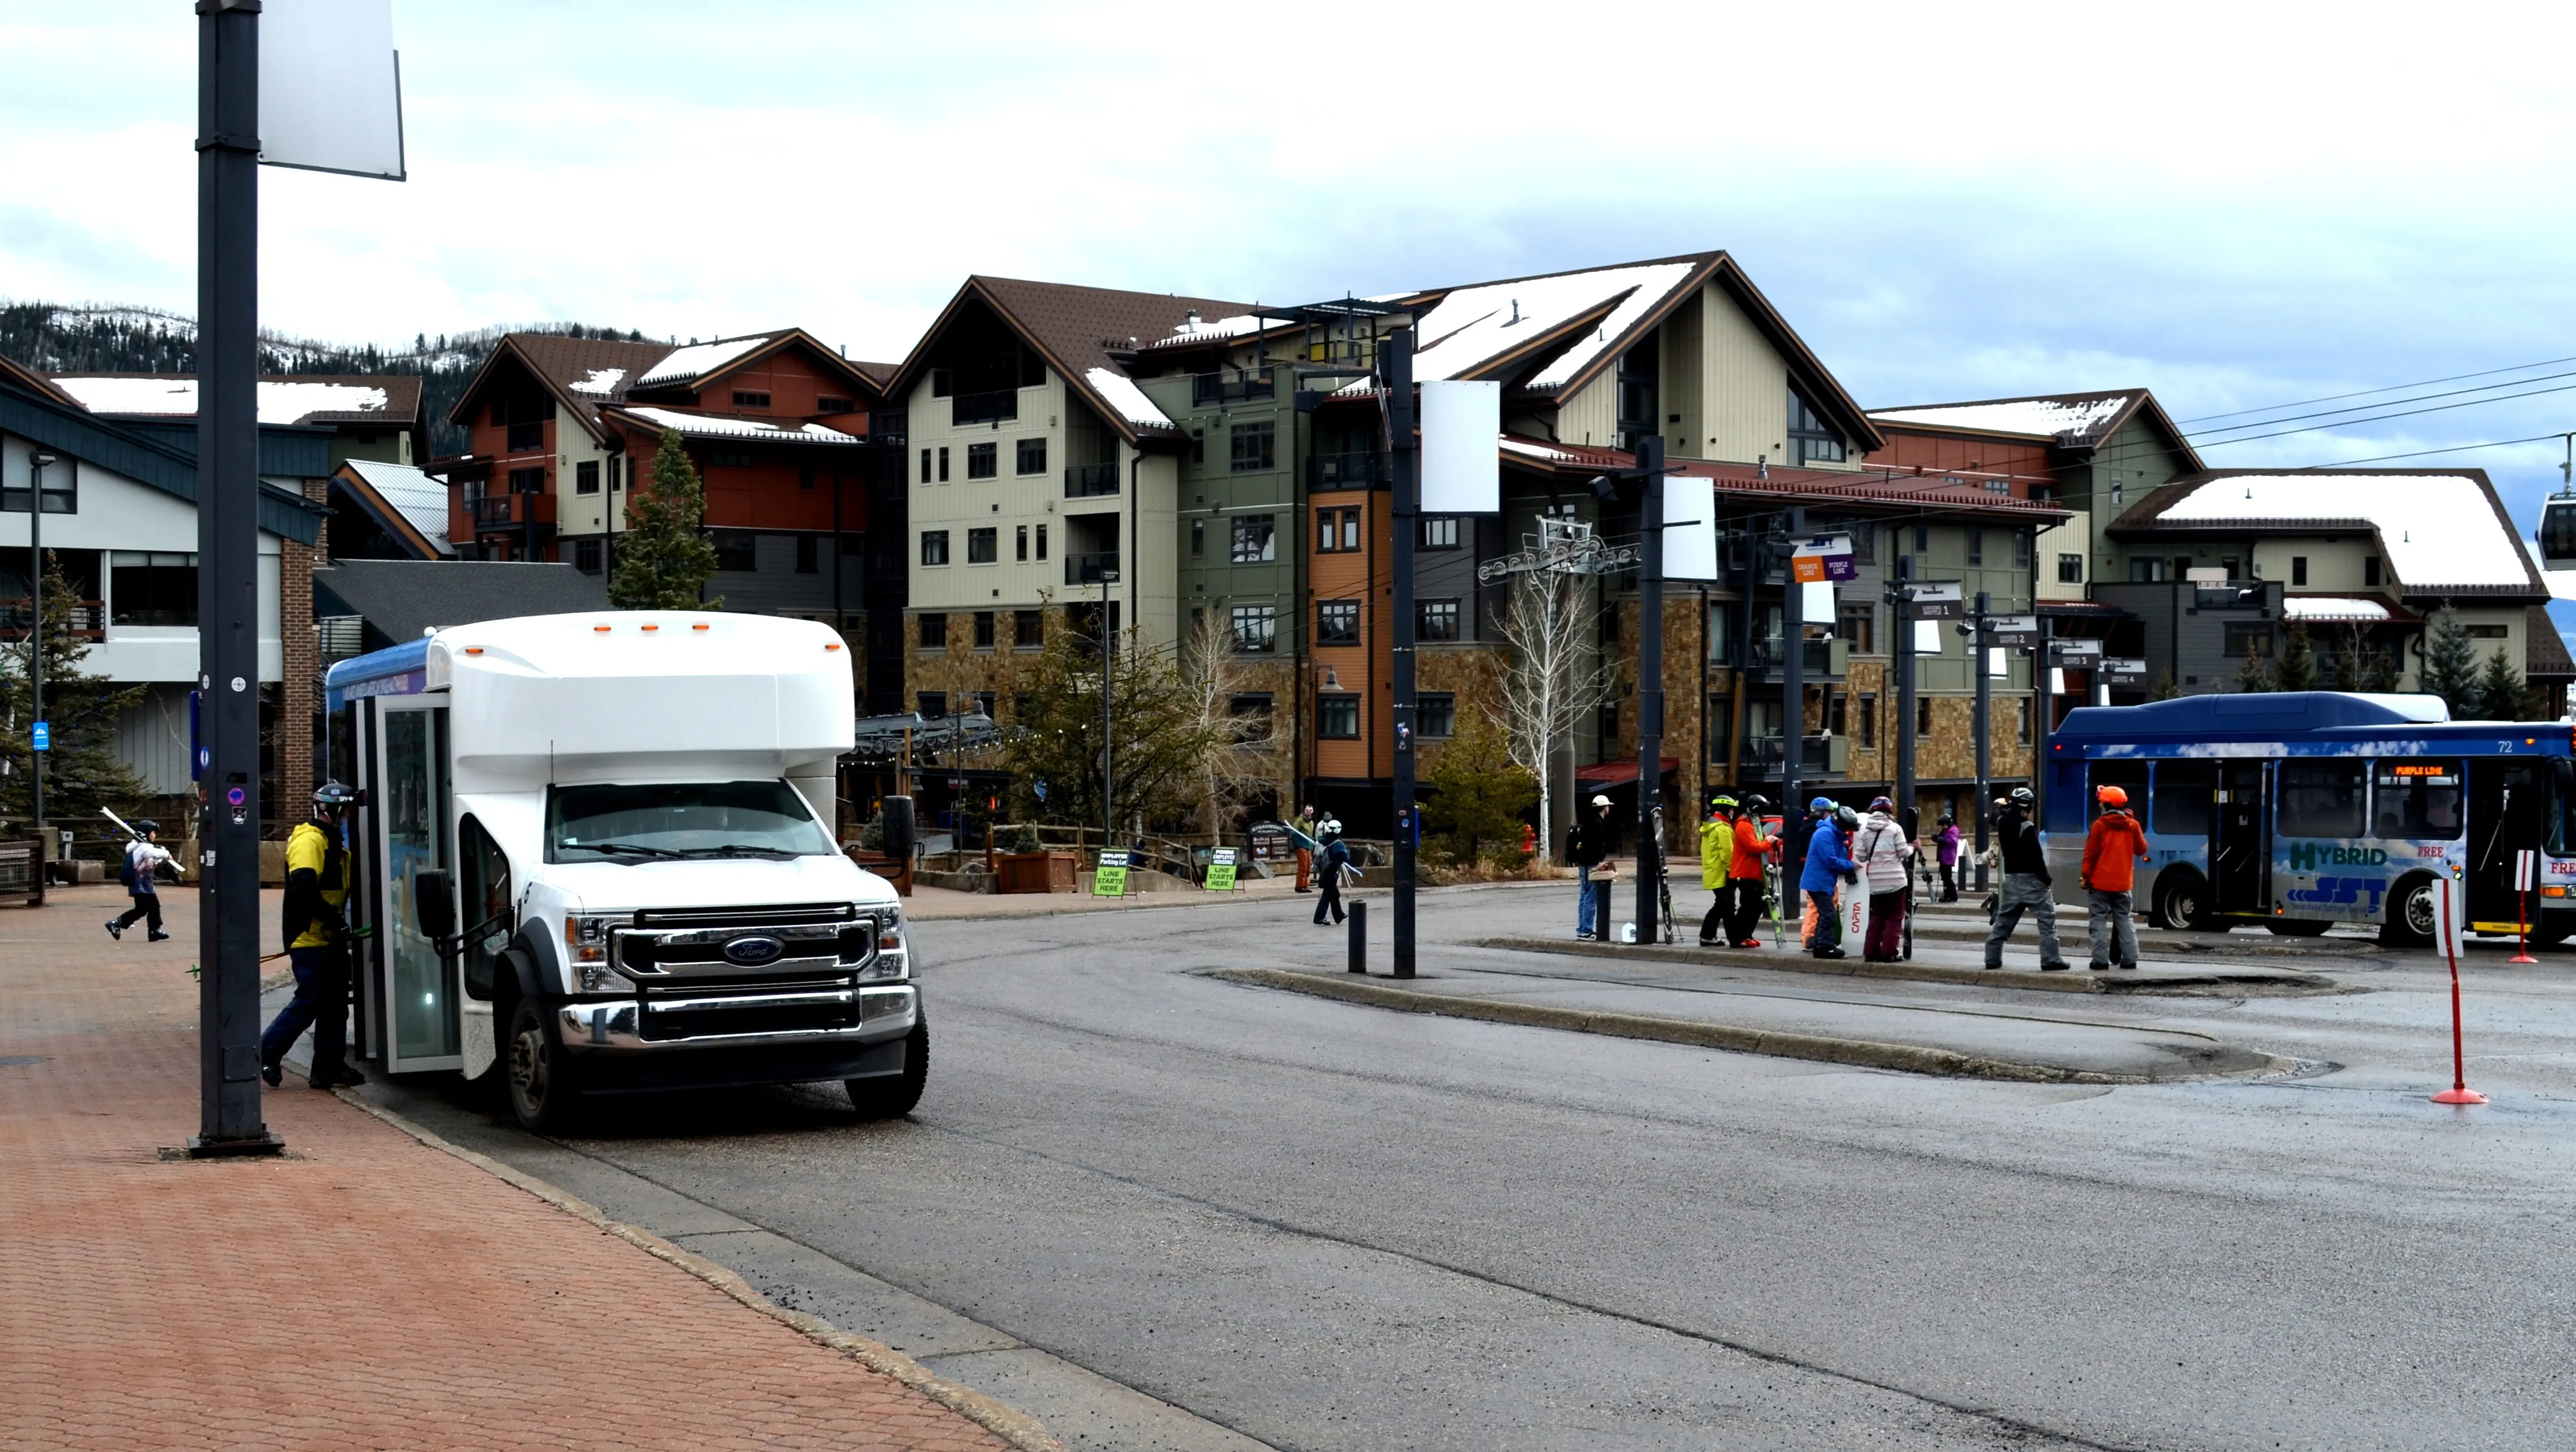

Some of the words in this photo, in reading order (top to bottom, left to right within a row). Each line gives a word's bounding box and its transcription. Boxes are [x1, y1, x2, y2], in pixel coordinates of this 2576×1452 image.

[1944, 605, 1949, 615] 1
[2019, 635, 2025, 643] 2
[2082, 657, 2087, 665] 3
[2498, 741, 2512, 753] 72
[2396, 766, 2424, 776] PURPLE
[2425, 766, 2443, 776] LINE
[2290, 841, 2387, 871] HYBRID
[2417, 846, 2444, 857] FREE
[2551, 862, 2576, 874] FRE
[1851, 901, 1861, 934] CAPITA
[739, 943, 769, 956] Ford
